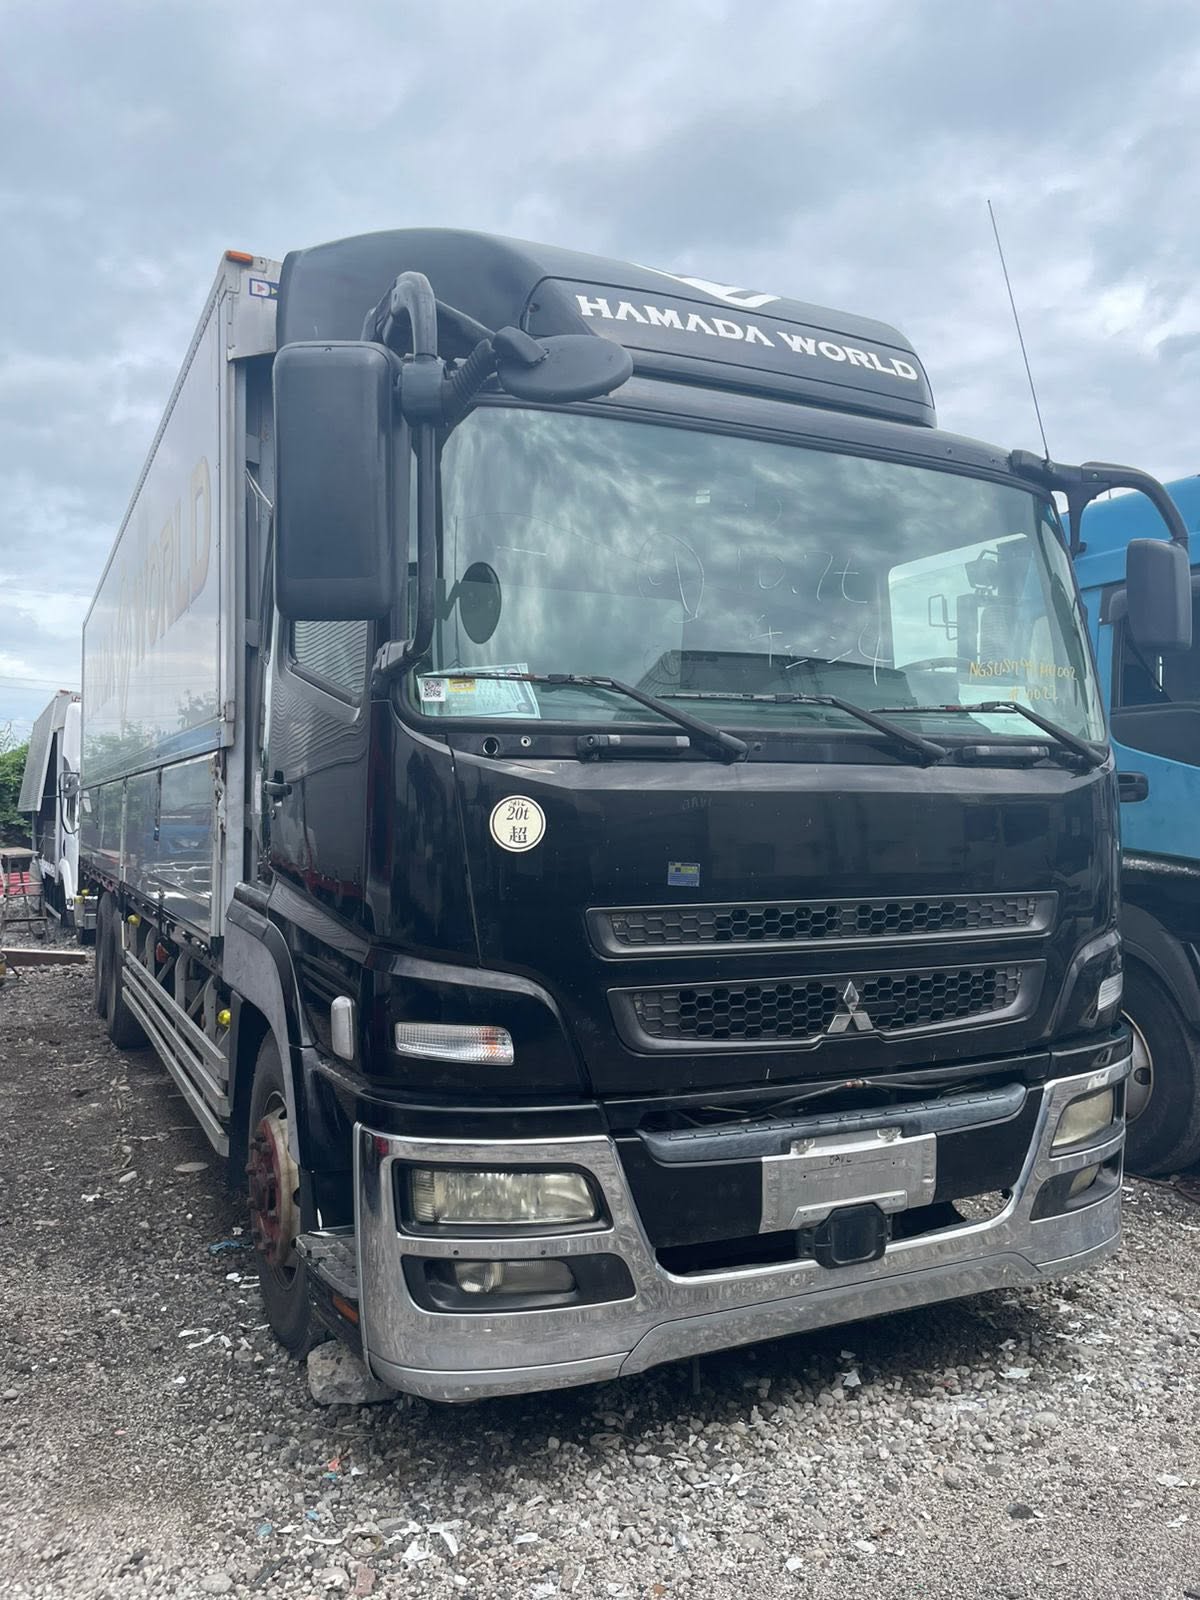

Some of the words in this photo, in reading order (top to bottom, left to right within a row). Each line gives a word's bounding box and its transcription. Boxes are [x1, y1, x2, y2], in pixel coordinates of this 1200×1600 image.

[575, 294, 775, 347] HAMADA
[776, 331, 918, 381] WORLD
[506, 806, 529, 821] 20t
[508, 826, 528, 844] 超
